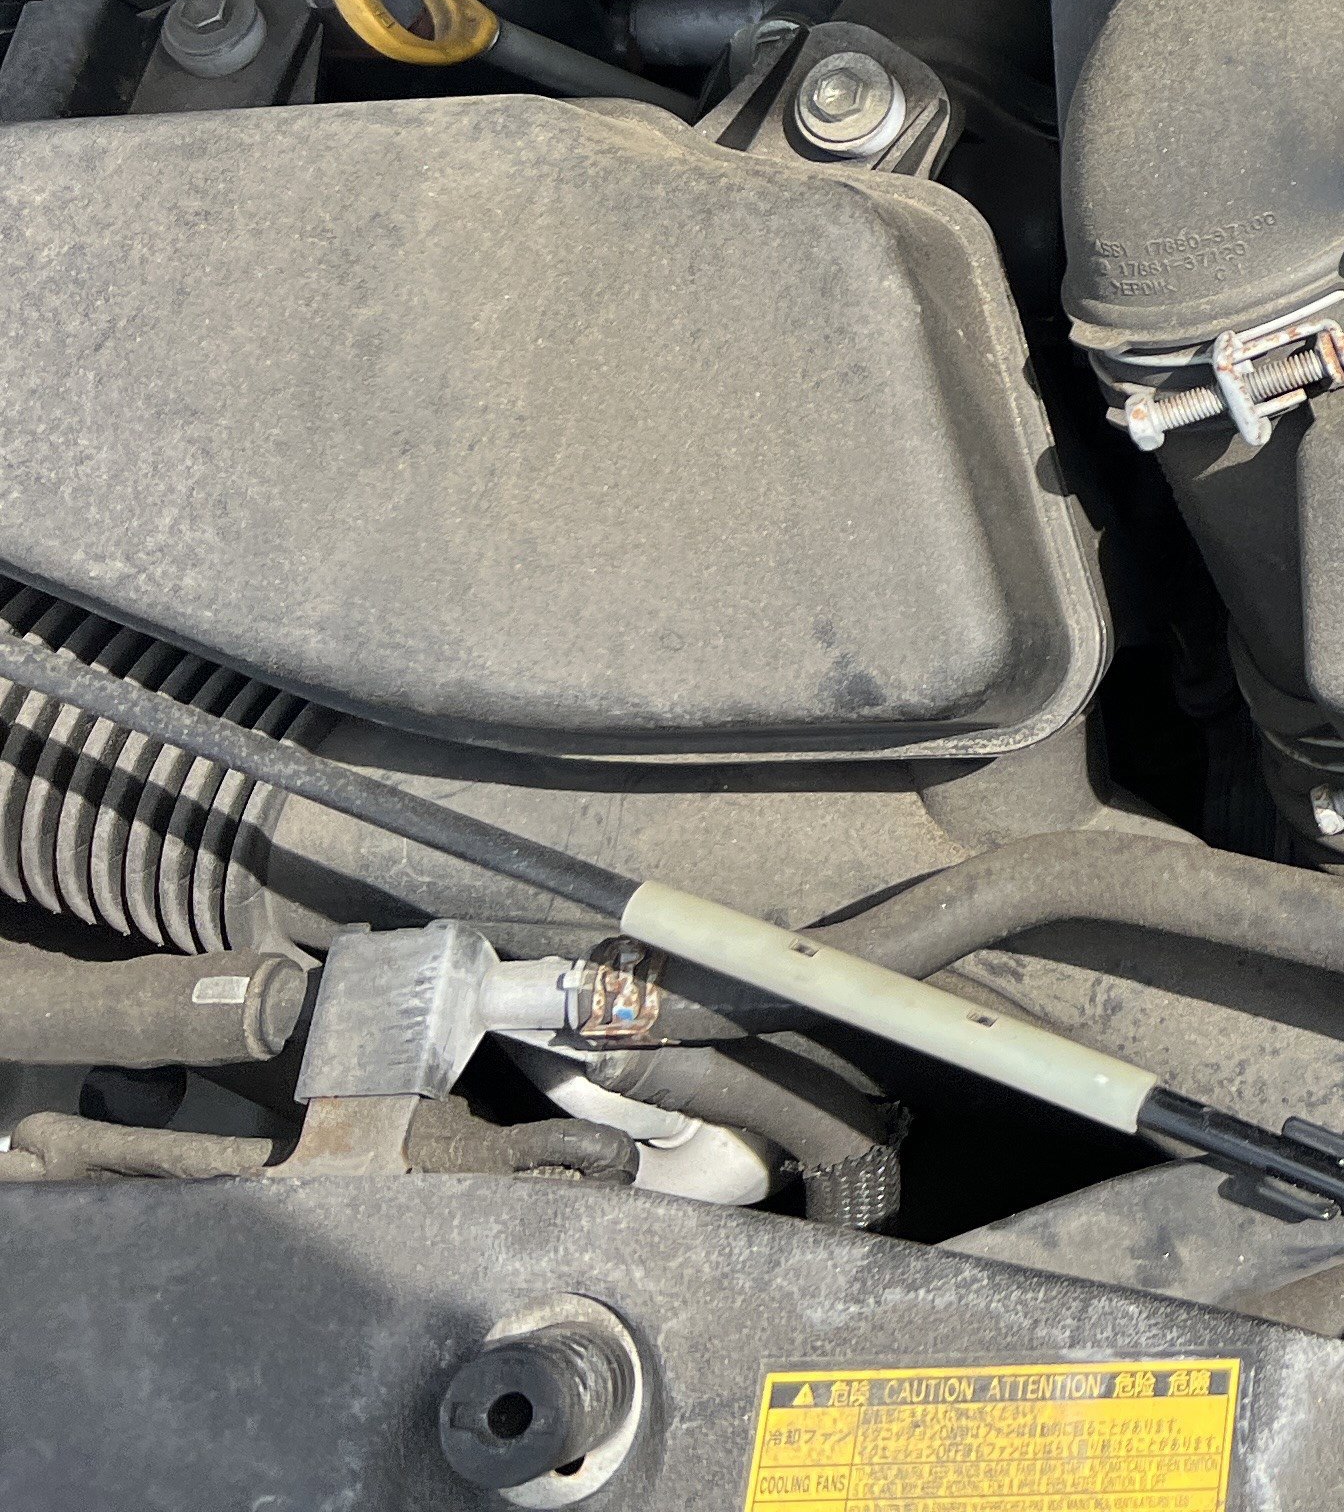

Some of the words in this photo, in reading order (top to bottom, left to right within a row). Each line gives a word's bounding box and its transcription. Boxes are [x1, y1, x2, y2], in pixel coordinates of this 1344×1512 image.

[884, 1377, 976, 1404] CAUTION
[987, 1373, 1101, 1399] ATTENTION
[767, 1428, 852, 1446] 冷却ファン
[759, 1476, 810, 1495] COOLING
[815, 1474, 845, 1493] FANS
